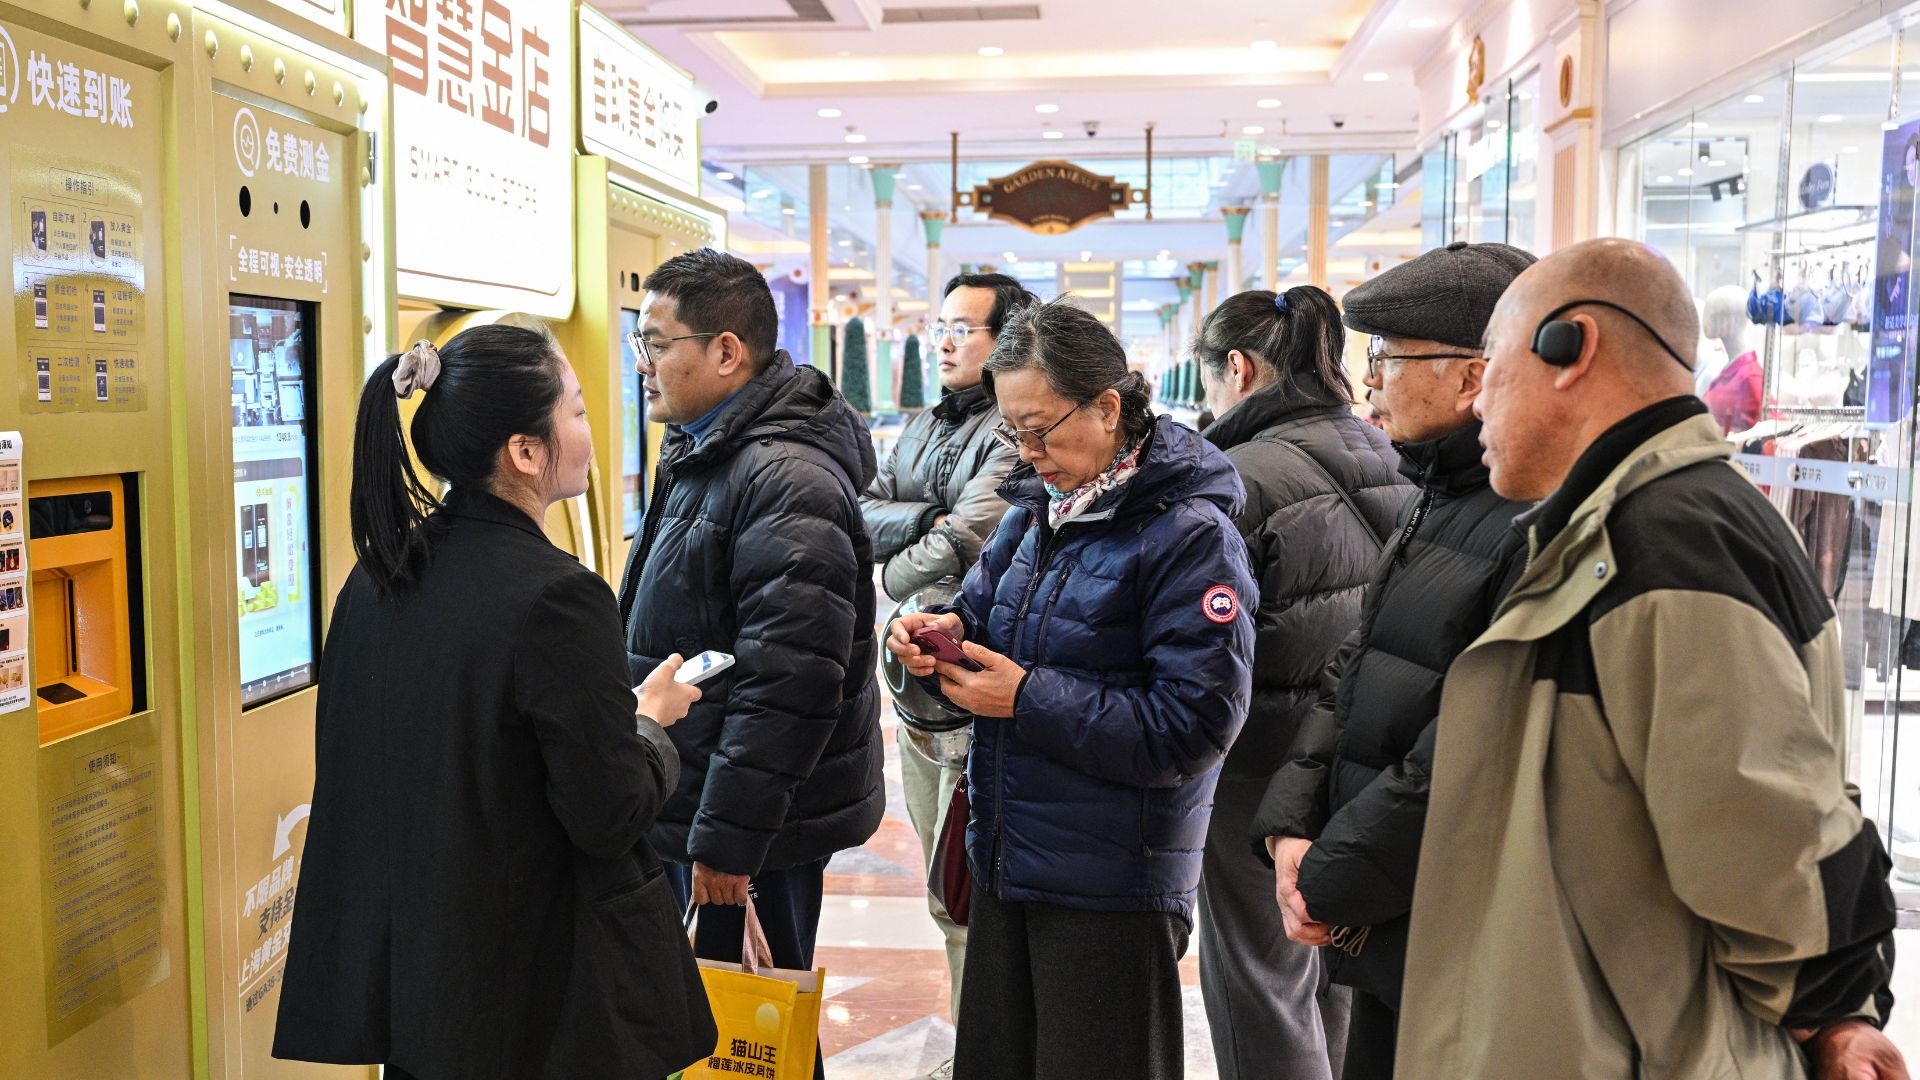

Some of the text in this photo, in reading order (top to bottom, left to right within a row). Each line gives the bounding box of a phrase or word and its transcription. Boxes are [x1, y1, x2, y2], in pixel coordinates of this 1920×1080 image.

[27, 50, 134, 129] 快速到账
[385, 0, 549, 148] 智慧金店
[265, 126, 330, 184] 免费测金
[65, 177, 94, 196] 操作指引
[1003, 168, 1056, 194] GARDEN
[82, 212, 87, 223] 2
[238, 246, 324, 285] 全程可视·安全透明
[242, 856, 295, 918] 不限品牌
[730, 1038, 777, 1064] 猫山王
[707, 1056, 776, 1080] 榴莲冰皮月饼
